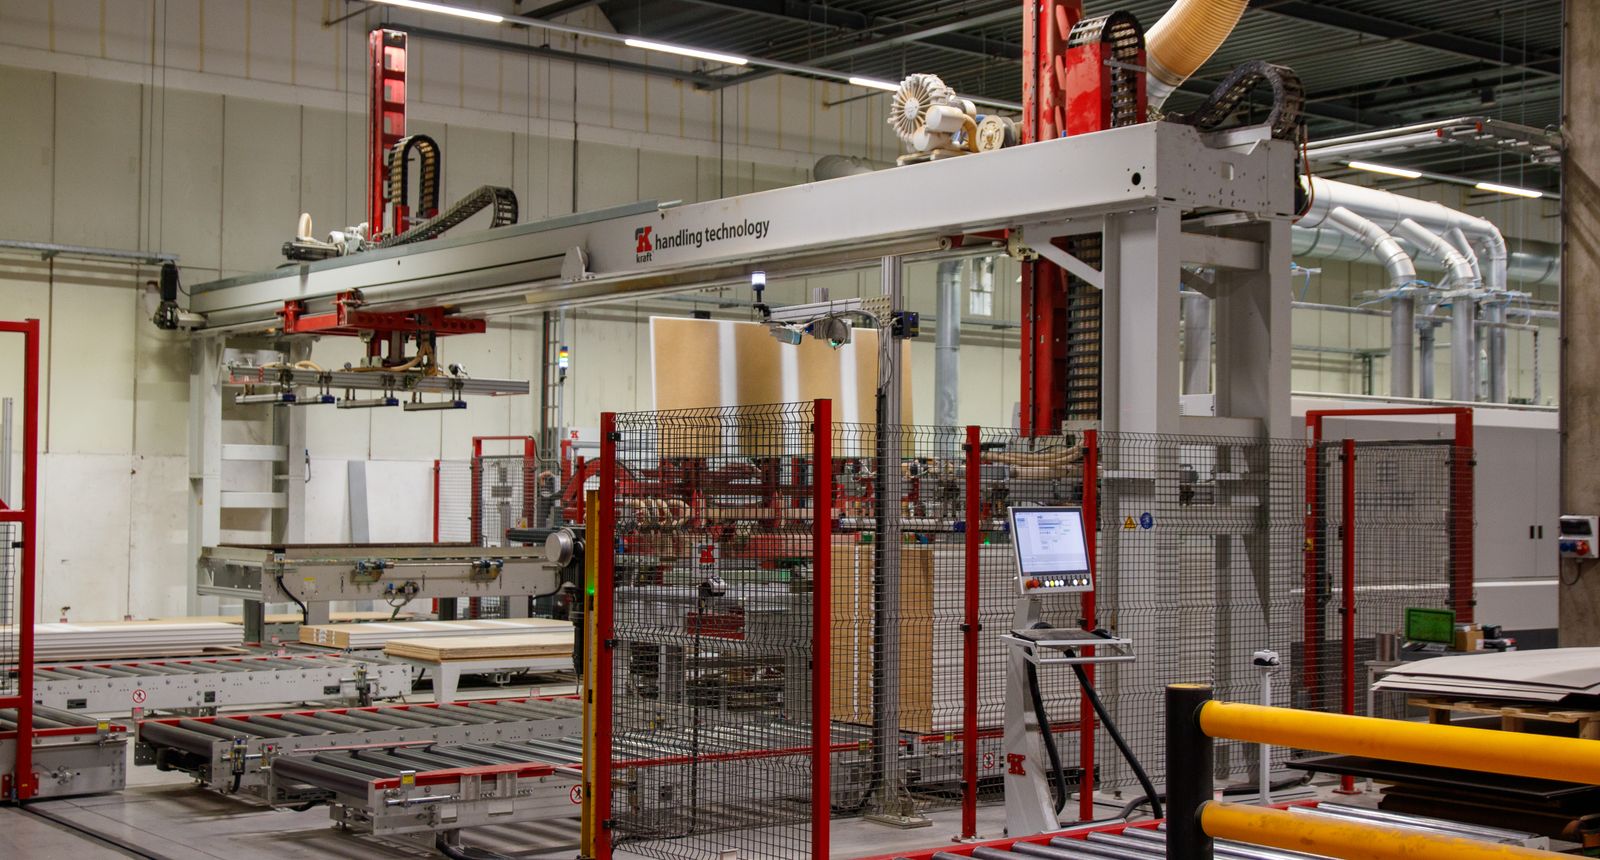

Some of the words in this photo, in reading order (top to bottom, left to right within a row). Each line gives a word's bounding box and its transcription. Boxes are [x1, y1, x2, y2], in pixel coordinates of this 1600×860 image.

[655, 228, 702, 250] handling
[705, 218, 770, 242] technology
[636, 252, 652, 263] kraft
